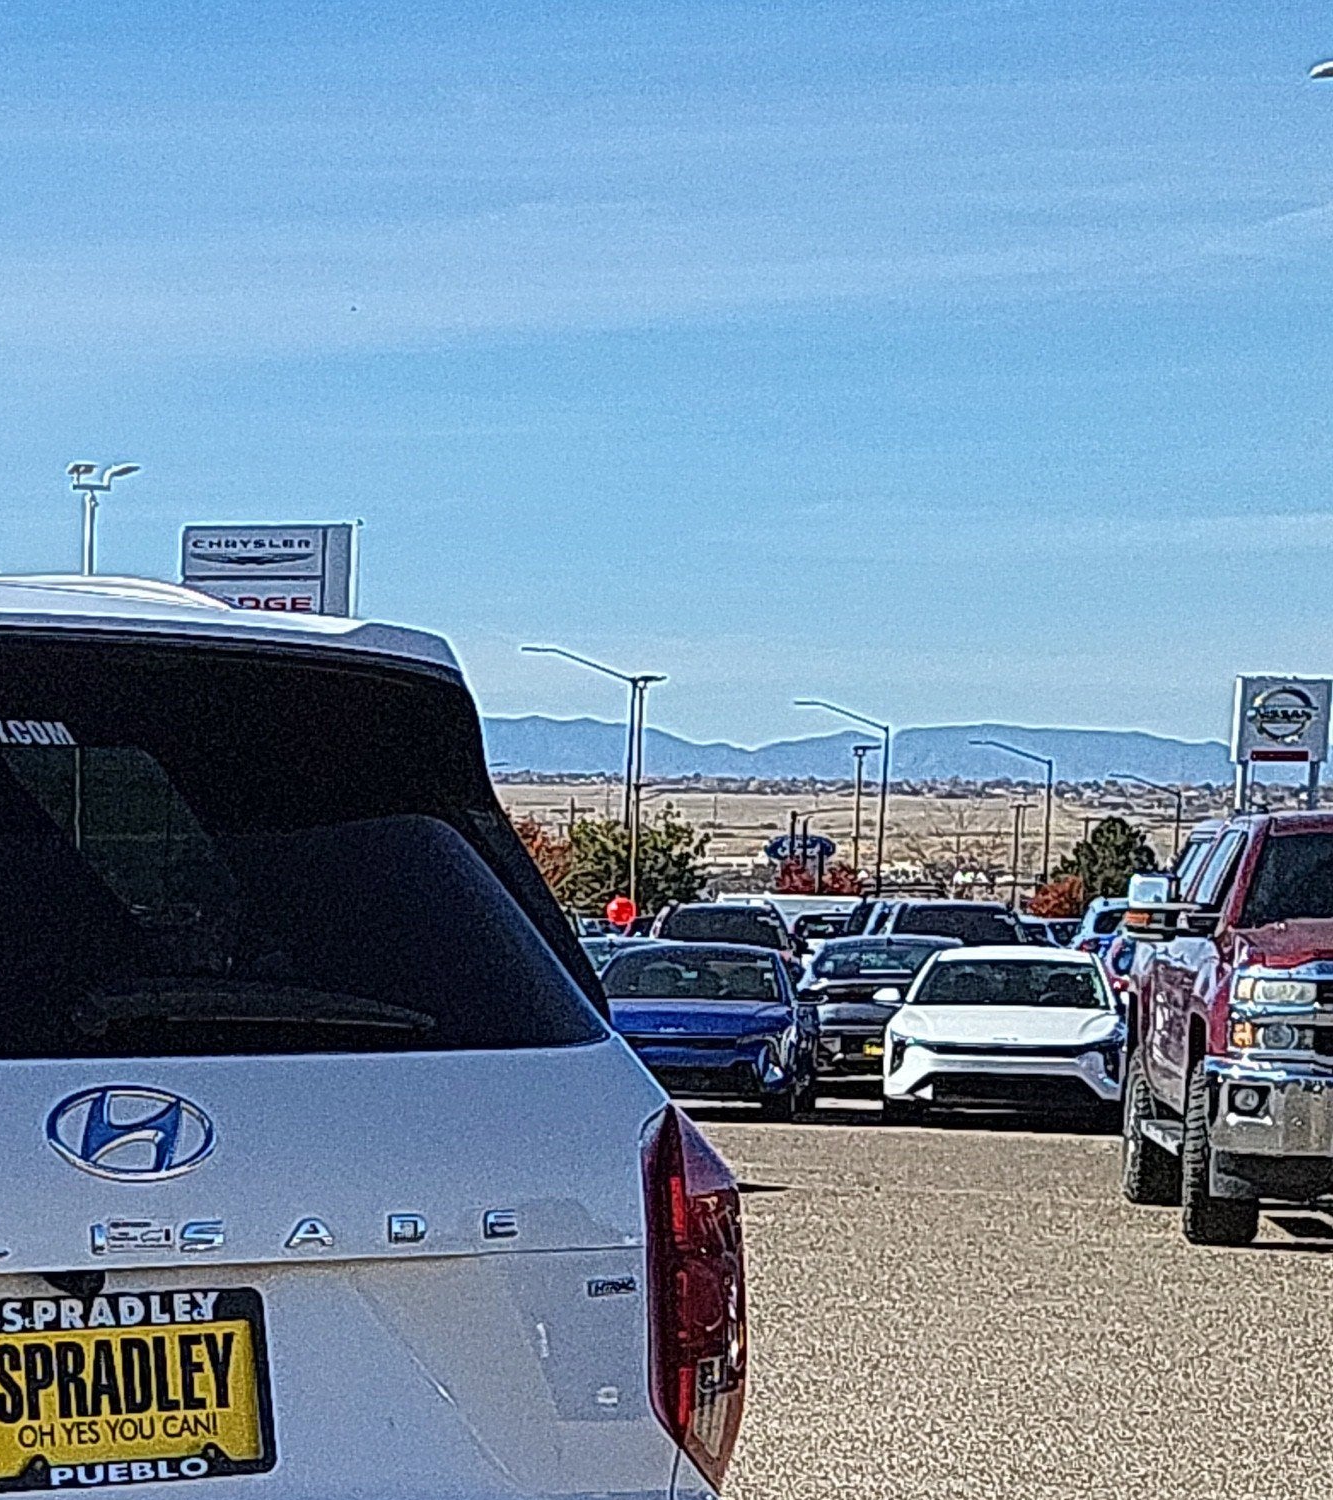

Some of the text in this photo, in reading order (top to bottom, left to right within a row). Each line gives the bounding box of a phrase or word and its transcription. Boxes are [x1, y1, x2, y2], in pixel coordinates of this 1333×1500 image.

[191, 538, 311, 549] CHRYSLER
[18, 1411, 219, 1449] OH YES YOU CAN!
[49, 1456, 210, 1486] PUEBLO
